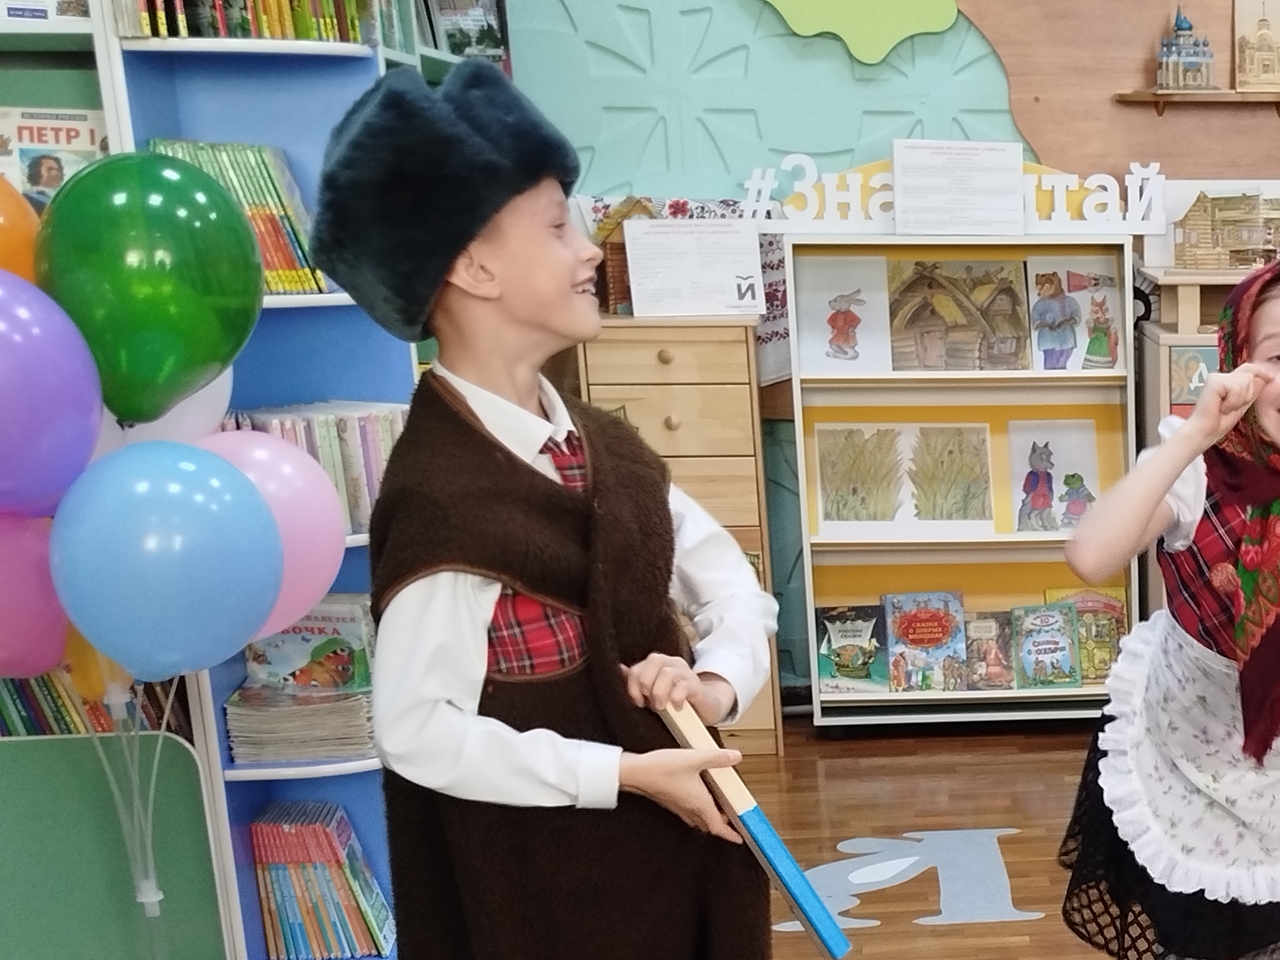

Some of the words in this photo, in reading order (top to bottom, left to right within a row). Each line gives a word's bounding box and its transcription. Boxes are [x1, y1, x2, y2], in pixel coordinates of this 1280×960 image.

[17, 126, 81, 145] ПЕТР
[738, 153, 1167, 222] #Знатай
[281, 626, 342, 636] БОЧКА
